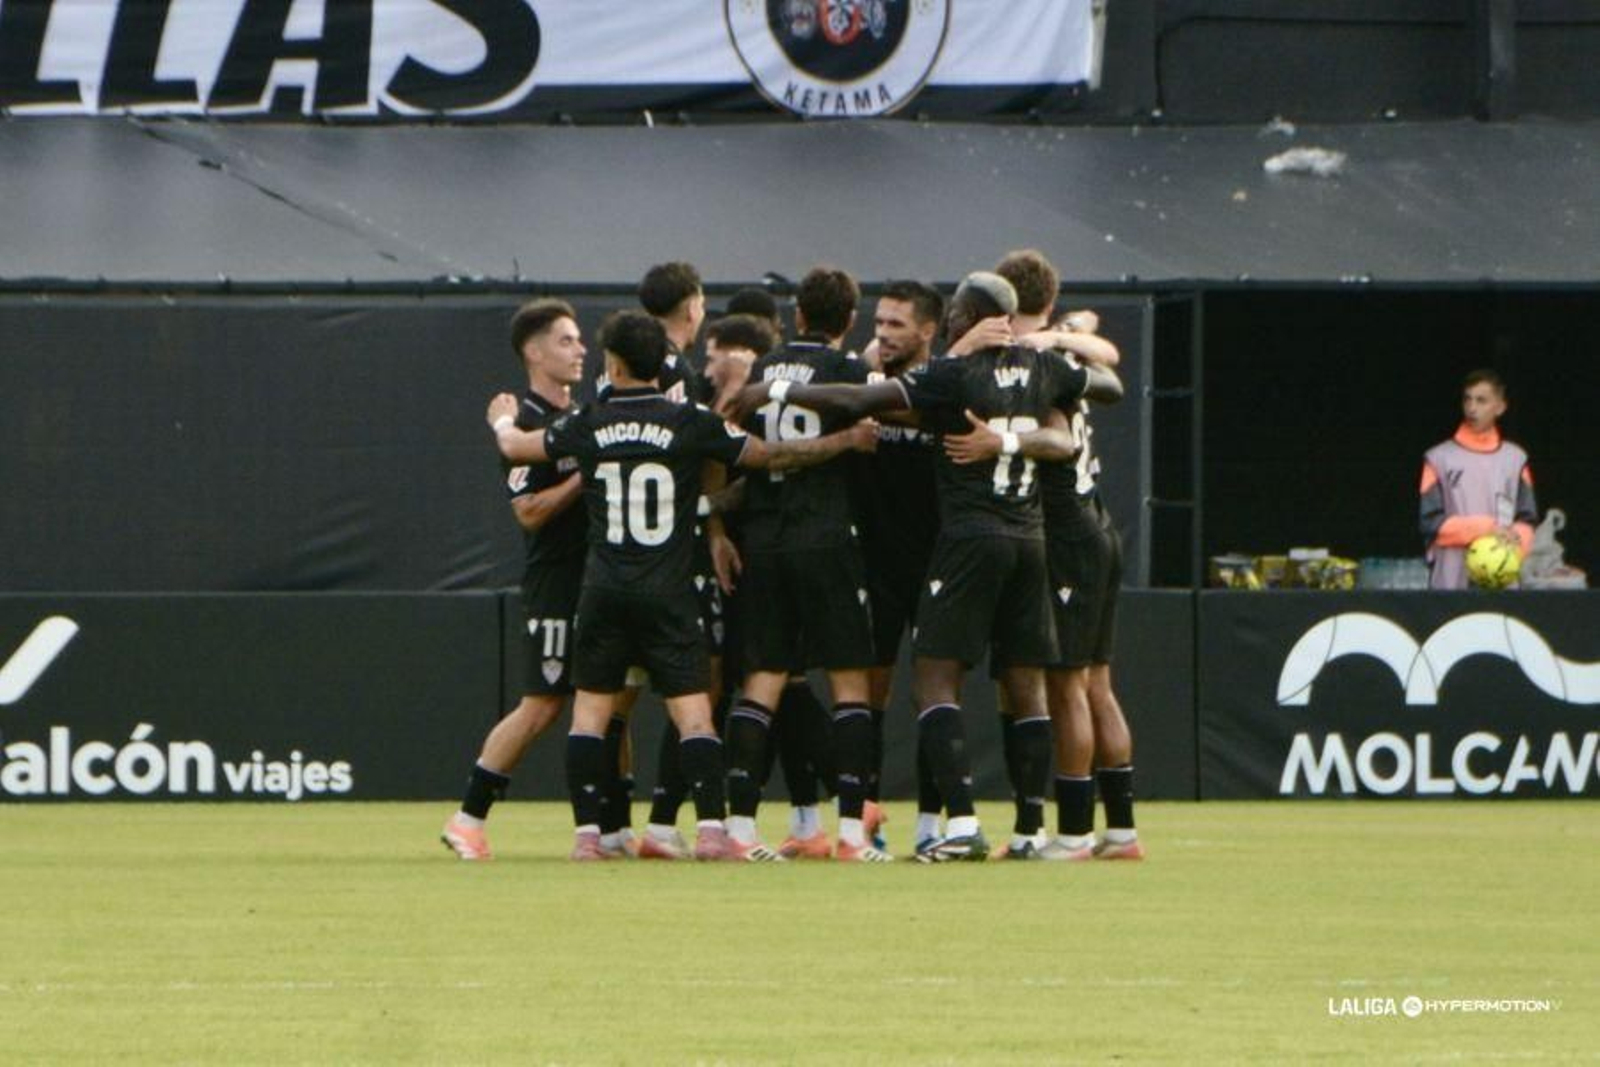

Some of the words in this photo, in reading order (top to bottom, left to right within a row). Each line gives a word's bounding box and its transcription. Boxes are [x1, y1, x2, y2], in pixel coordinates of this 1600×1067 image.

[784, 80, 892, 111] KETAMA
[595, 461, 676, 546] 10
[541, 618, 567, 657] 11
[0, 723, 216, 795] alcón
[222, 750, 353, 801] viajes
[1279, 731, 1600, 795] MOLCAN
